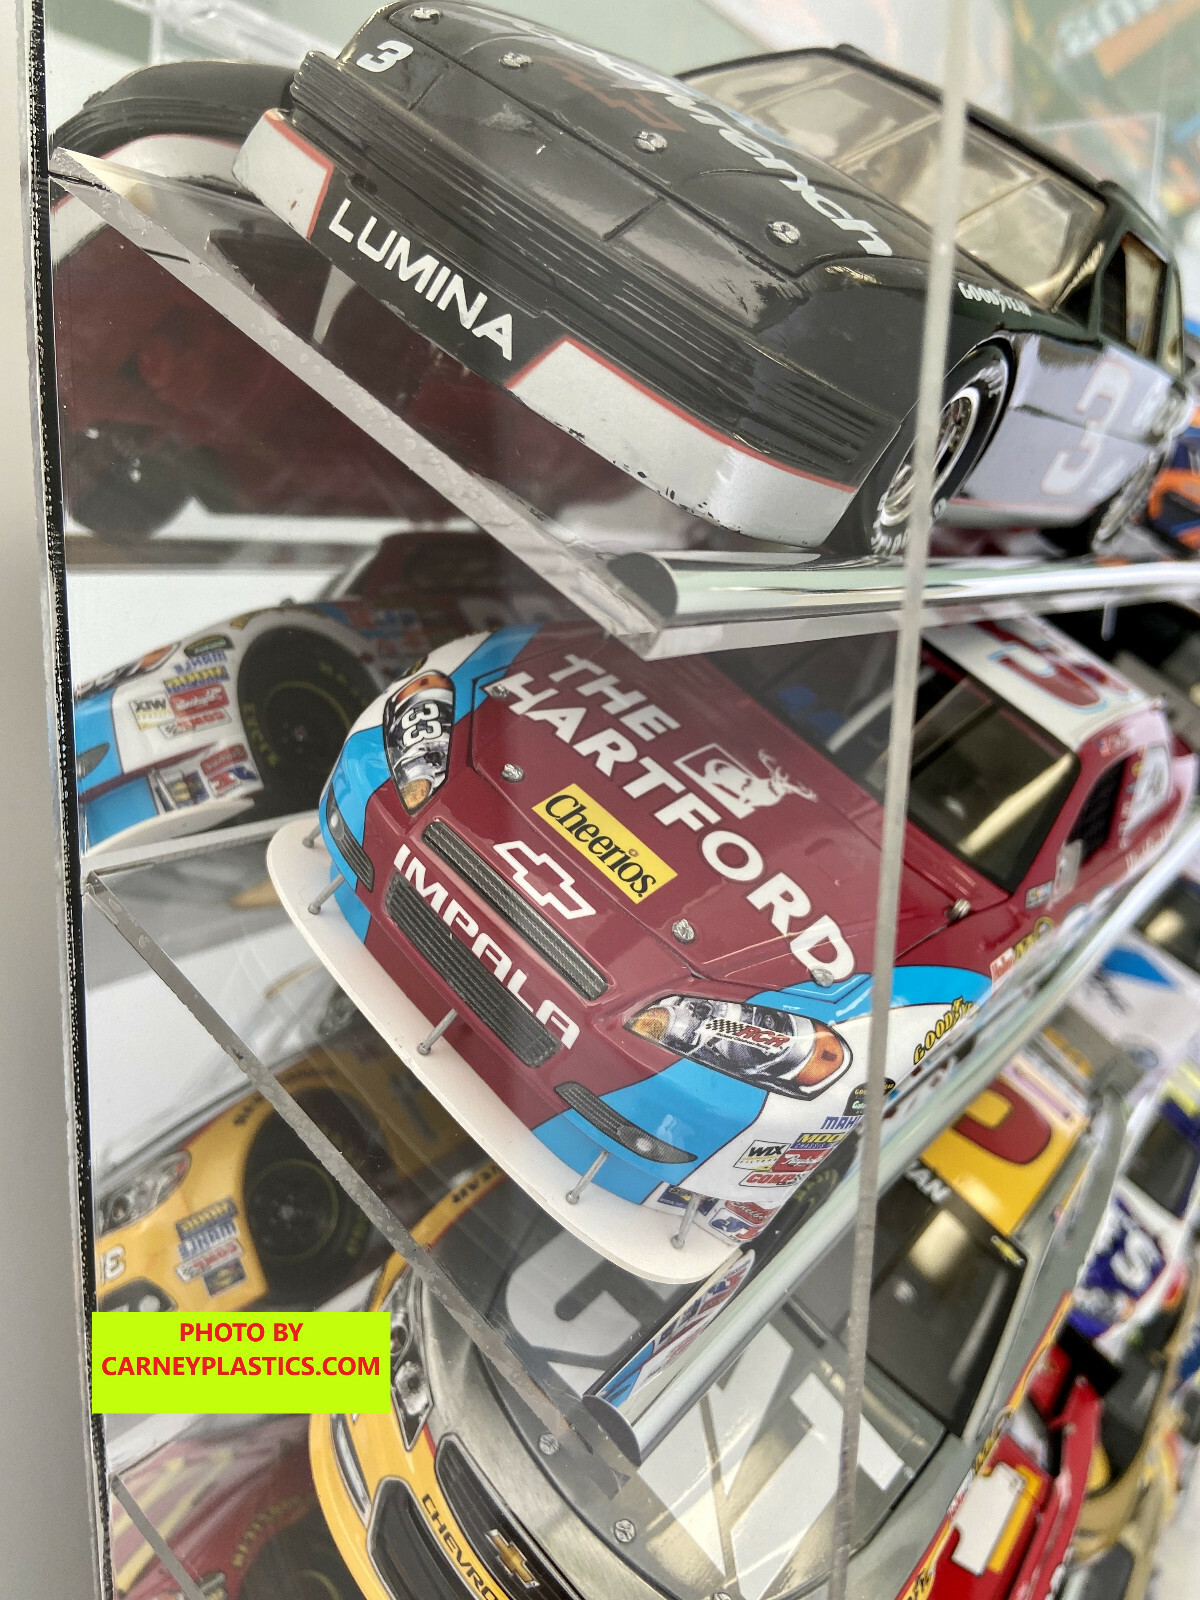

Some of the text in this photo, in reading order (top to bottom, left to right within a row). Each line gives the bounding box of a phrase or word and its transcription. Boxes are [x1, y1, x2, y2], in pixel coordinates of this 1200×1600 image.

[356, 40, 414, 73] 3
[328, 198, 513, 361] LUMINA
[1041, 360, 1132, 495] 3
[401, 702, 443, 746] 33
[548, 653, 680, 742] THE
[500, 671, 856, 982] HARTFORD
[394, 843, 581, 1050] IMPALA
[735, 1025, 790, 1048] RCR
[746, 1173, 797, 1184] COMP
[748, 1144, 787, 1157] WIX
